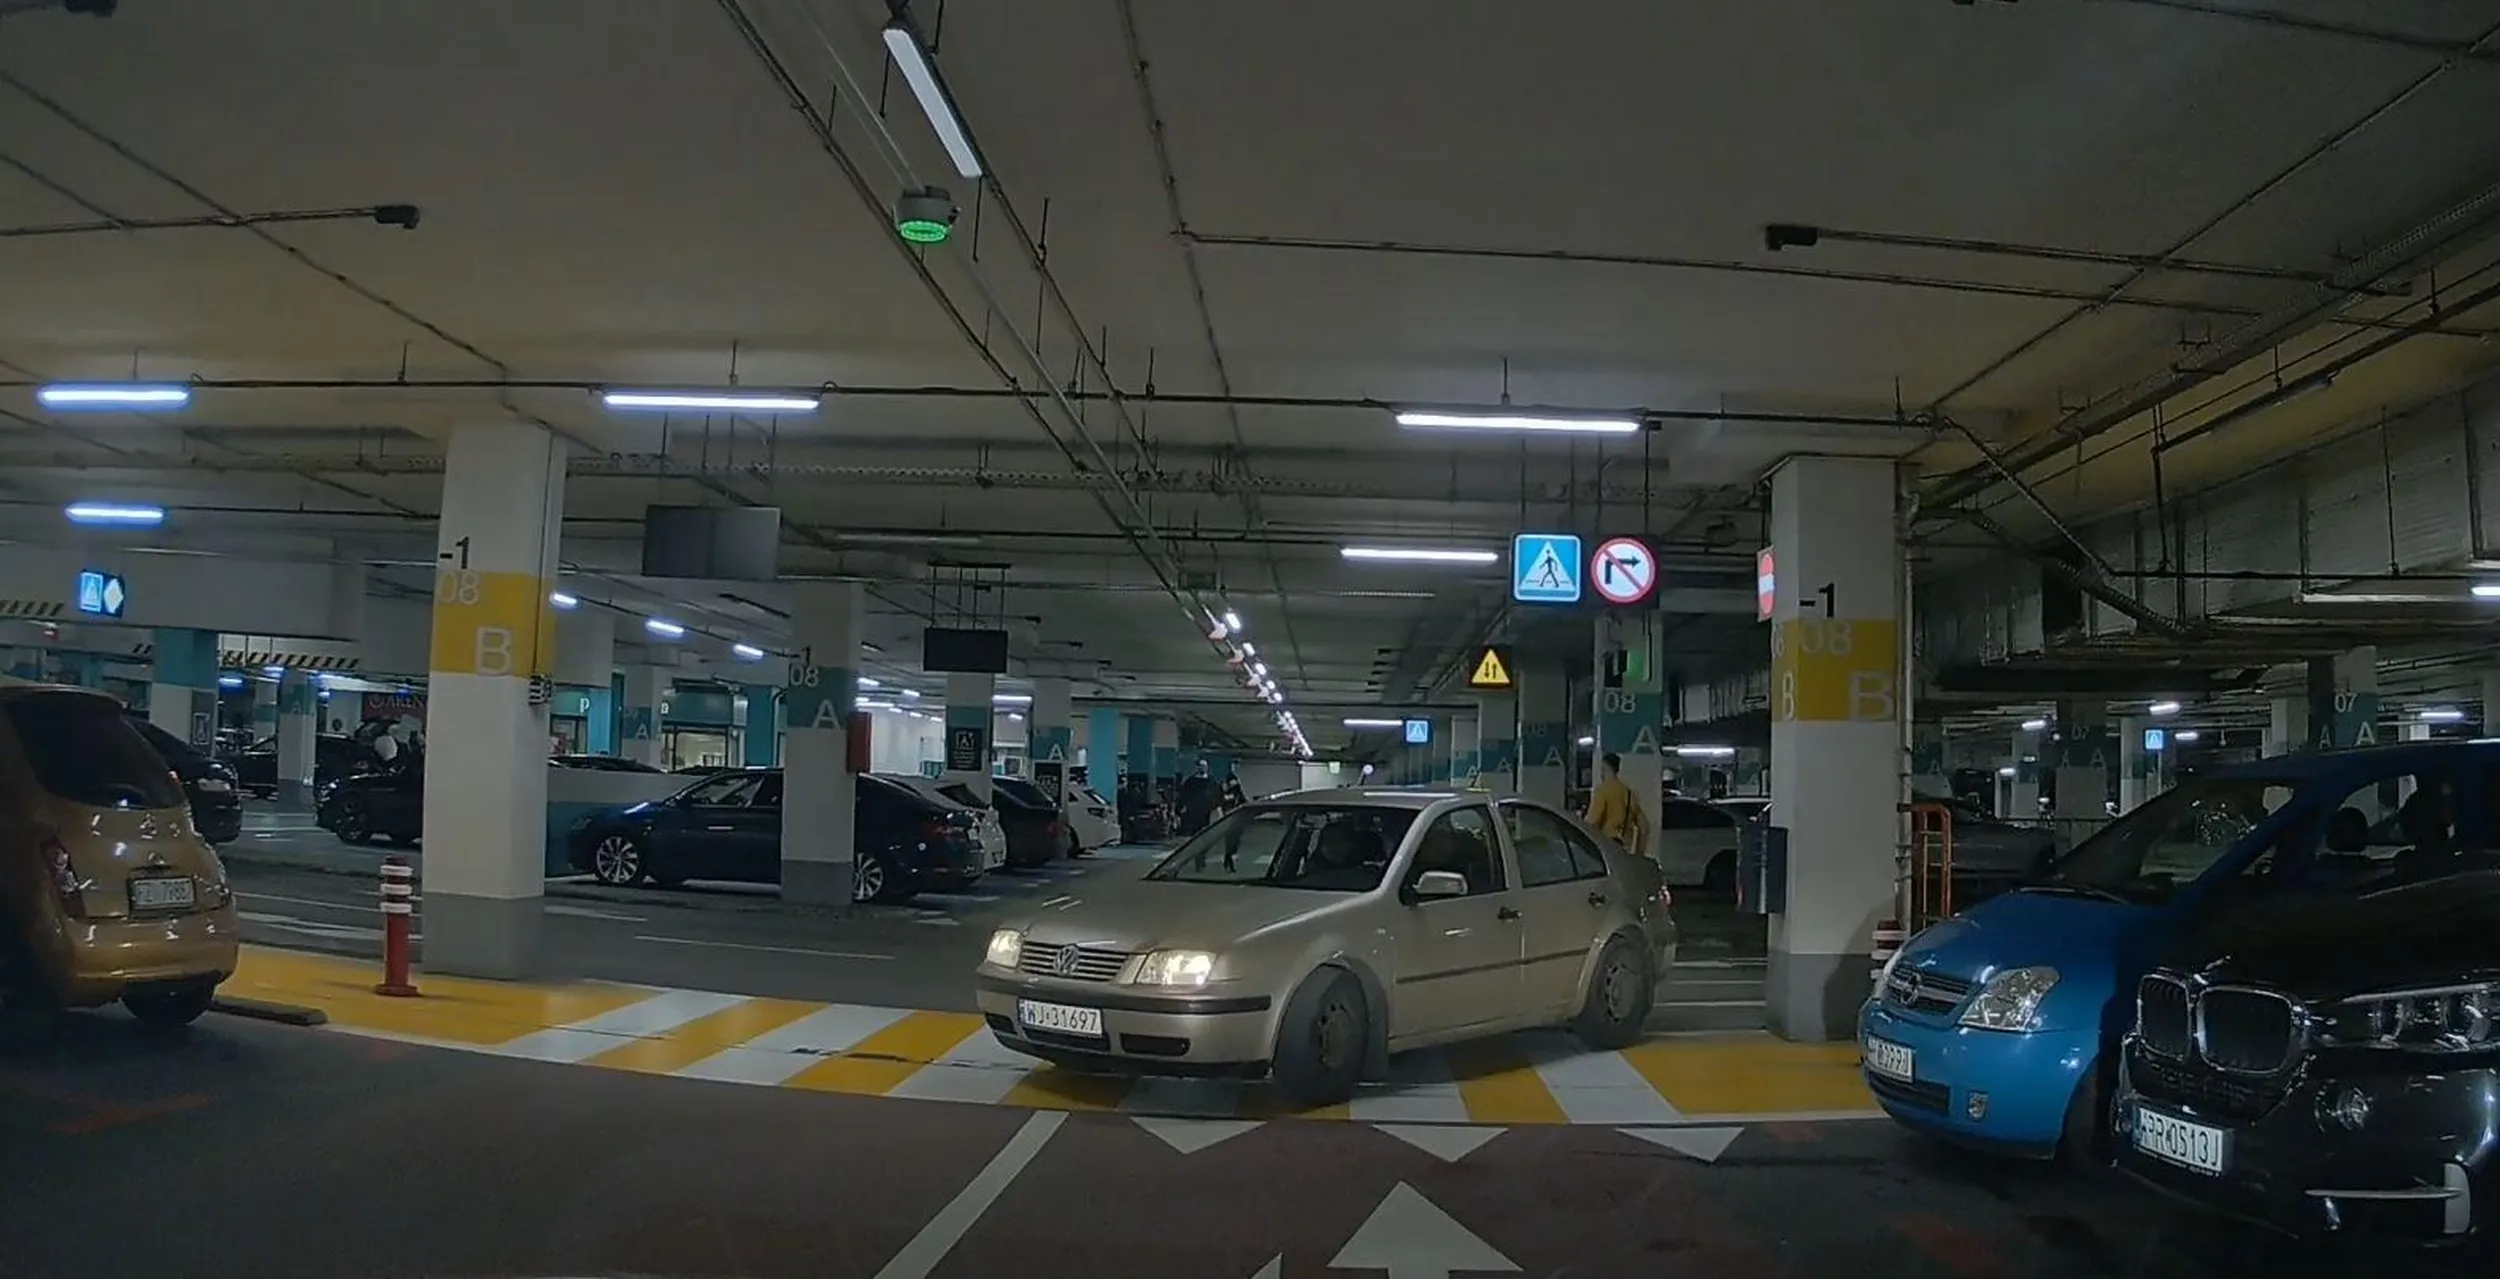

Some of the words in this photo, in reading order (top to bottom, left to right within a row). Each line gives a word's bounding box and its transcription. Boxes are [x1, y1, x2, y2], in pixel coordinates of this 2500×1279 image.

[440, 536, 470, 569] -1
[439, 571, 480, 605] 08
[1800, 581, 1835, 618] -1
[476, 626, 514, 677] B
[1801, 621, 1853, 656] 08
[790, 666, 819, 687] 08
[1604, 690, 1636, 713] 08
[1782, 670, 1796, 720] B
[1851, 670, 1895, 720] B
[2334, 692, 2358, 713] 07
[812, 699, 841, 728] A
[634, 723, 651, 740] A
[1633, 725, 1662, 754] A
[2319, 724, 2332, 749] A
[2355, 721, 2376, 747] A
[1049, 743, 1064, 760] A
[1496, 757, 1514, 772] A
[1543, 745, 1565, 766] A
